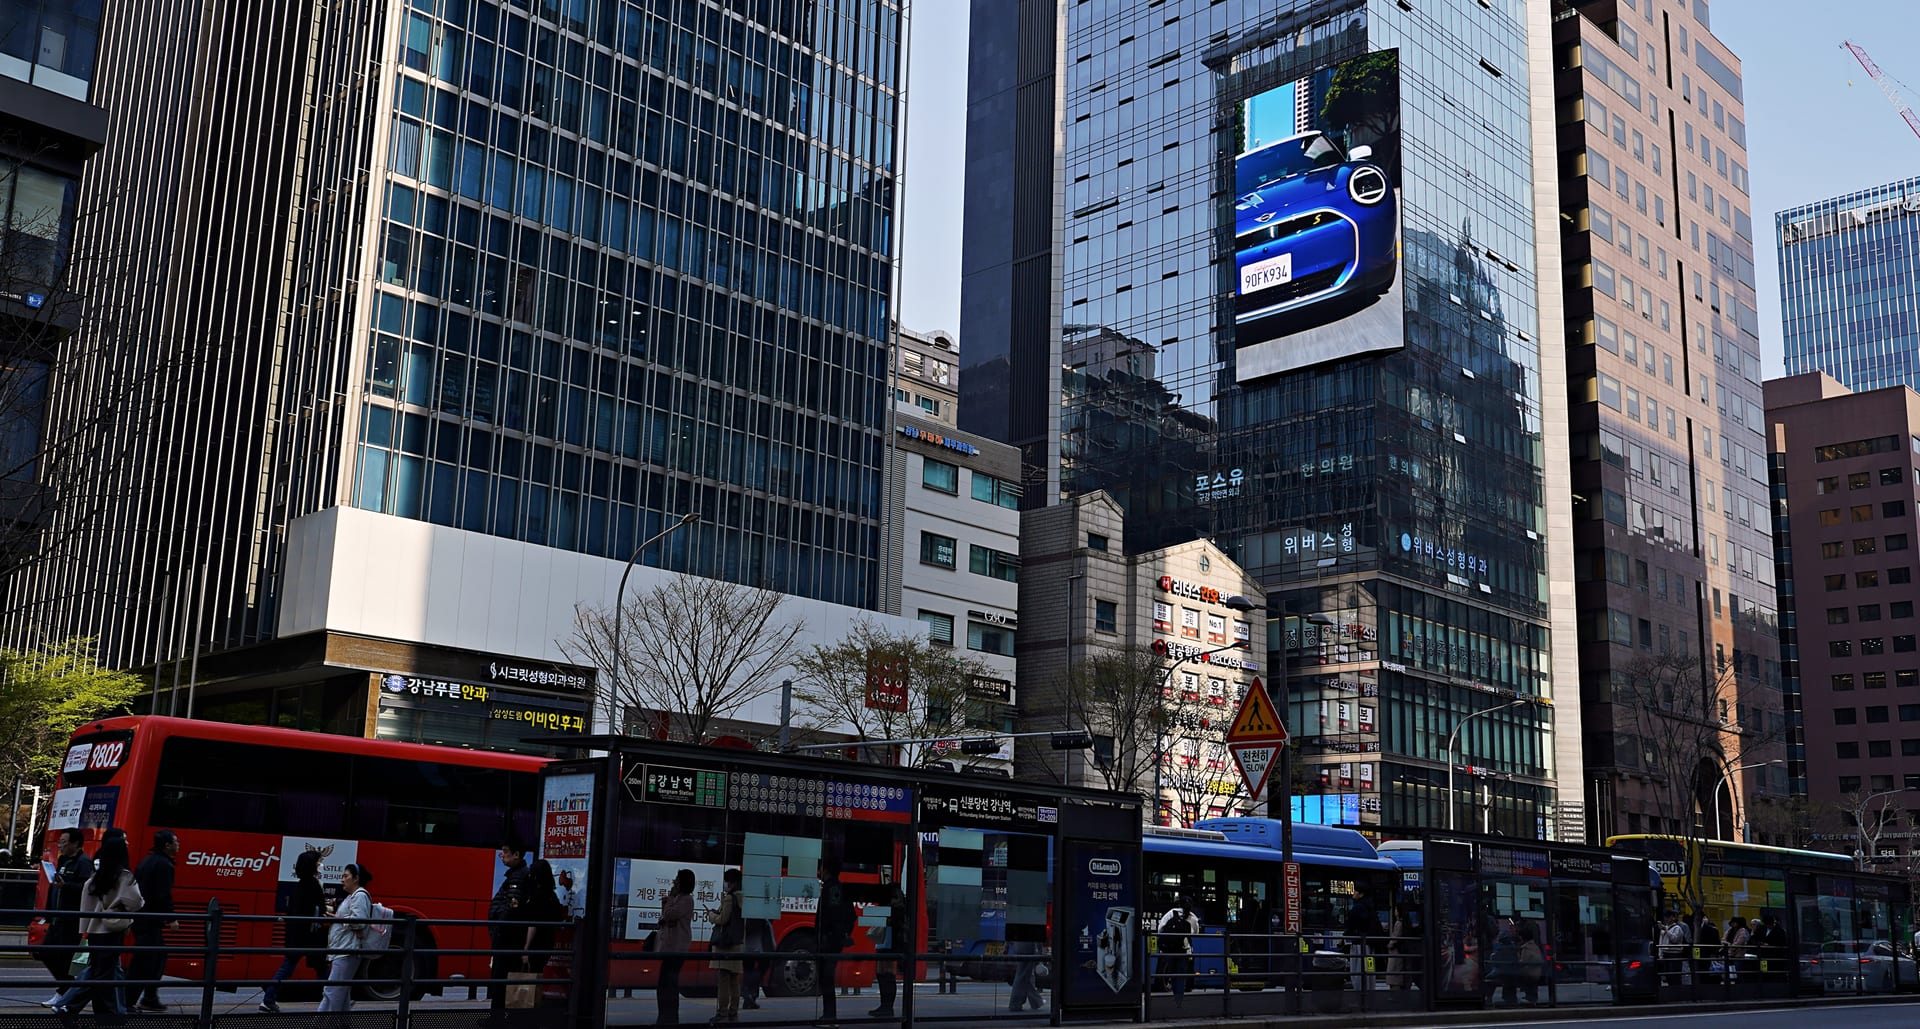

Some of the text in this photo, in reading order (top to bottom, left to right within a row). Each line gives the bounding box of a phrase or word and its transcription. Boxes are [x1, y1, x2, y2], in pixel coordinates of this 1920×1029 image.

[1245, 265, 1288, 288] 90FK934
[1302, 455, 1353, 478] 한의원
[1196, 469, 1244, 491] 포스유
[1284, 532, 1336, 554] 위버스
[1413, 536, 1488, 576] 위버스성형외과
[498, 666, 586, 690] 시크릿성형외과의원
[407, 678, 487, 702] 강남푸른안과
[523, 710, 585, 733] 이비인후과
[91, 743, 124, 768] 9802
[1242, 750, 1268, 763] 천천히
[1246, 763, 1265, 773] SLOW
[657, 774, 692, 790] 강남역
[547, 798, 590, 811] HELLO KITTY
[960, 795, 988, 811] 신분당선
[990, 800, 1011, 813] 강남역
[548, 826, 566, 837] 50주년
[186, 851, 265, 872] Shinkang
[637, 888, 656, 901] 계양
[1286, 865, 1299, 933] 무단횡단금지
